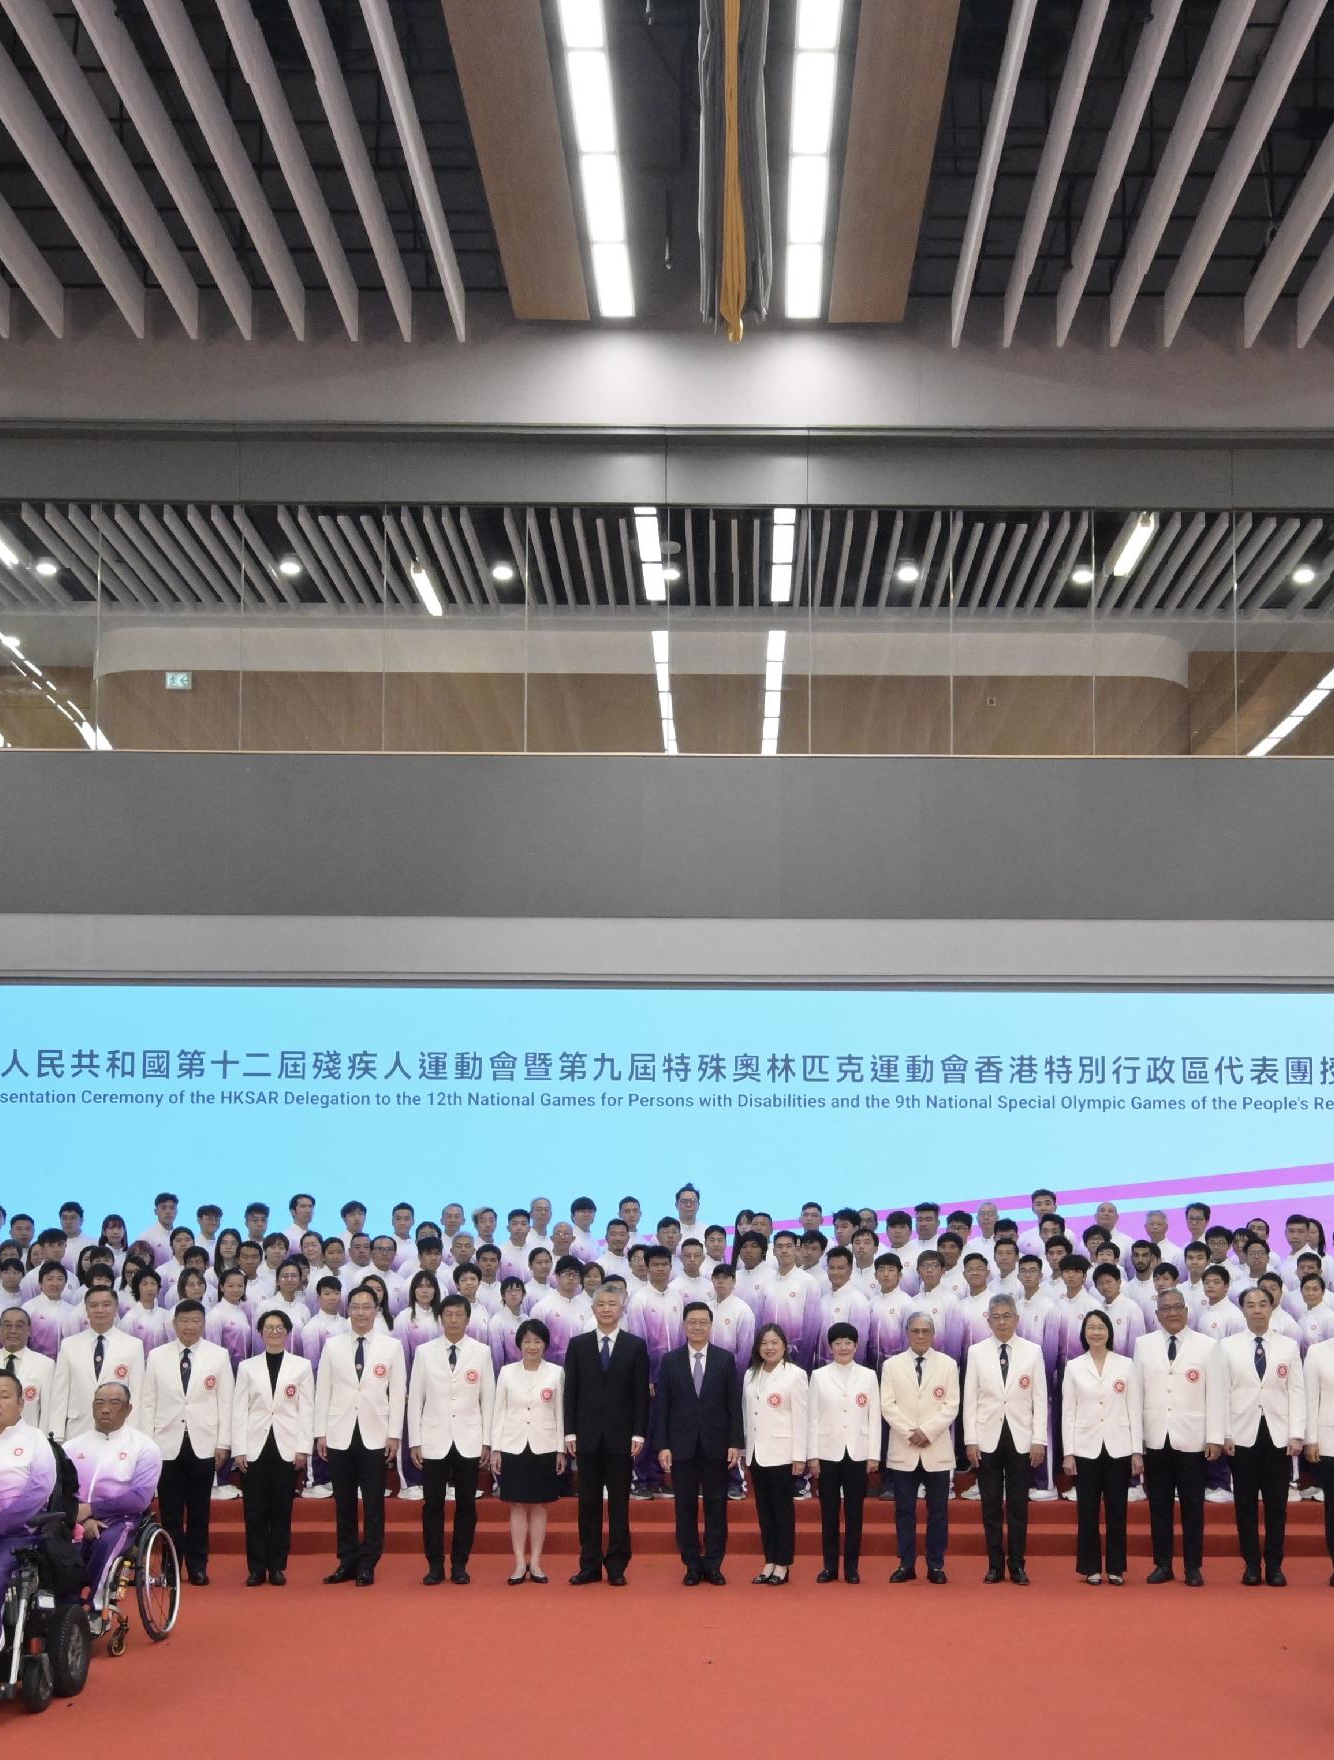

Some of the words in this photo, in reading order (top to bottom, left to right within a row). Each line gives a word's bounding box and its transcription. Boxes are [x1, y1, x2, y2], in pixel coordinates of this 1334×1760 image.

[81, 1089, 164, 1108] Ceremony
[168, 1089, 186, 1105] of
[189, 1089, 216, 1105] the
[220, 1090, 279, 1105] HKSAR
[284, 1090, 371, 1109] Delegation
[374, 1091, 391, 1106] to
[395, 1091, 422, 1106] the
[426, 1091, 463, 1106] 12th
[467, 1091, 535, 1107] National
[540, 1092, 596, 1107] Games
[600, 1091, 624, 1107] for
[628, 1093, 695, 1108] Persons
[698, 1093, 733, 1108] with
[737, 1093, 826, 1109] Disabilities
[830, 1093, 860, 1109] and
[865, 1093, 891, 1109] the
[895, 1093, 921, 1109] 9th
[926, 1094, 992, 1109] National
[997, 1094, 1056, 1113] Special
[1060, 1094, 1126, 1113] Olympic
[1130, 1095, 1186, 1110] Games
[1190, 1095, 1208, 1110] of
[1211, 1095, 1238, 1110] the
[1242, 1095, 1309, 1114] People's
